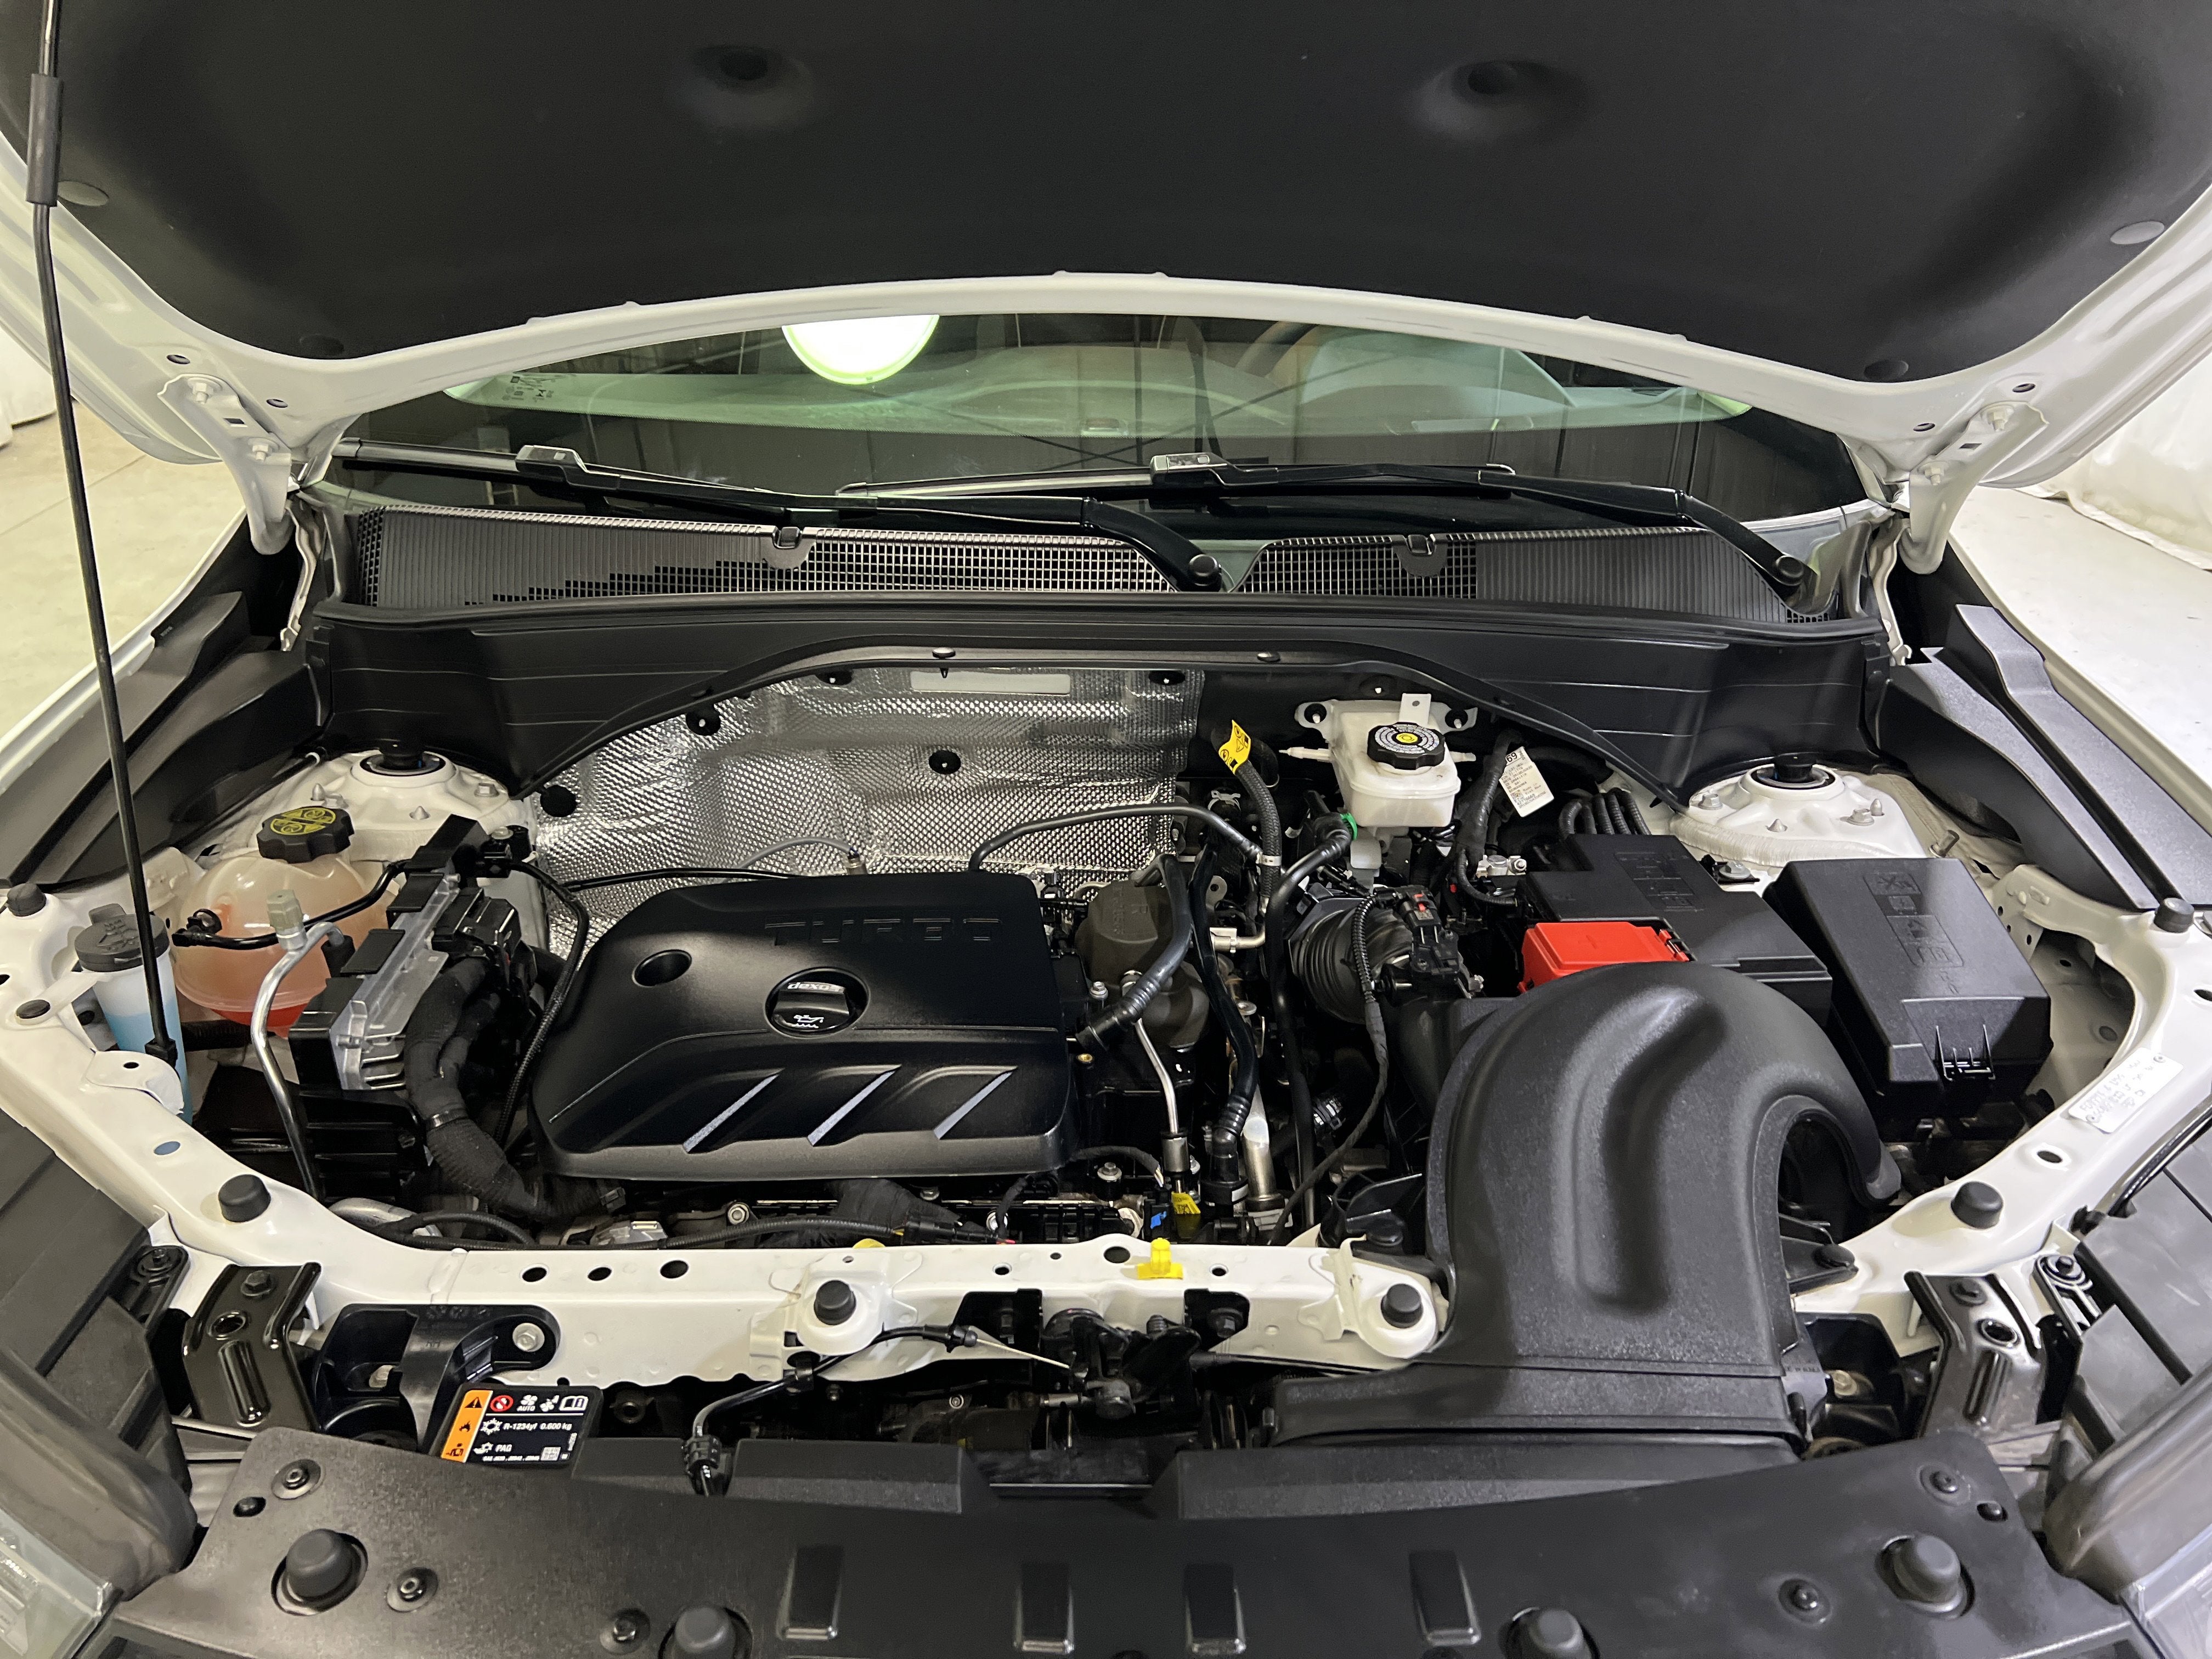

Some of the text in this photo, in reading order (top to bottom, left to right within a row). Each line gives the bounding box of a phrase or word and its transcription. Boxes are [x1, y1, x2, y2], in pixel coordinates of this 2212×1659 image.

[1506, 752, 1517, 762] 69
[503, 1423, 538, 1431] R-1234yf
[562, 1422, 572, 1431] kg
[495, 1444, 512, 1453] PAG
